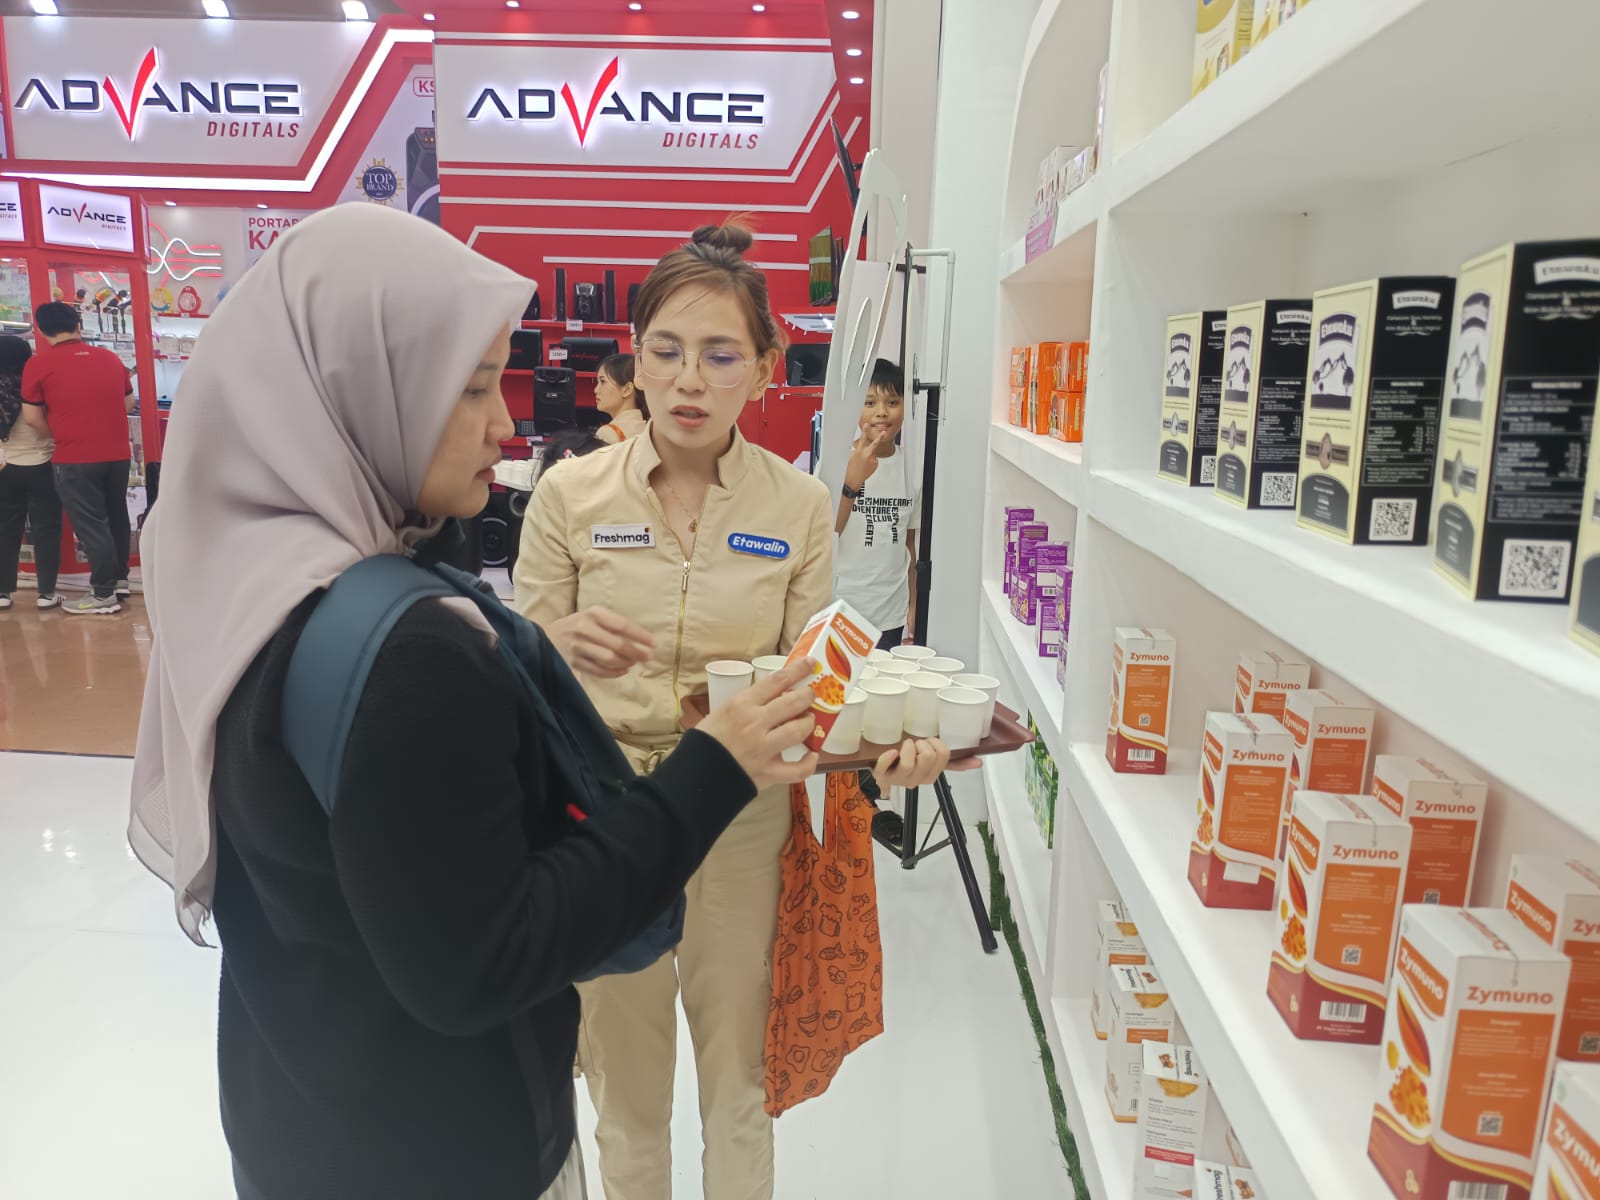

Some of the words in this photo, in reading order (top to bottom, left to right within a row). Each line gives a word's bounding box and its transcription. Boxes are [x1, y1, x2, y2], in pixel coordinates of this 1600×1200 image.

[14, 46, 302, 141] ADVANCE
[467, 55, 766, 148] ADVANCE
[207, 121, 299, 138] DIGITALS
[662, 132, 759, 150] DIGITALS
[366, 173, 392, 184] TOP
[47, 202, 127, 223] ADVANCE
[594, 534, 650, 544] Freshmag
[732, 535, 785, 554] Etawalin
[835, 618, 869, 650] Zymuno
[1129, 652, 1169, 662] Zymuno
[1258, 679, 1301, 690] Zymuno
[1318, 723, 1366, 735] Zymuno
[1232, 749, 1285, 761] Zymuno
[1415, 800, 1476, 814] Zymuno
[1332, 844, 1399, 860] Zymuno
[1510, 889, 1552, 932] Zymuno
[1400, 946, 1444, 1000] Zymuno
[1467, 985, 1554, 1005] Zymuno
